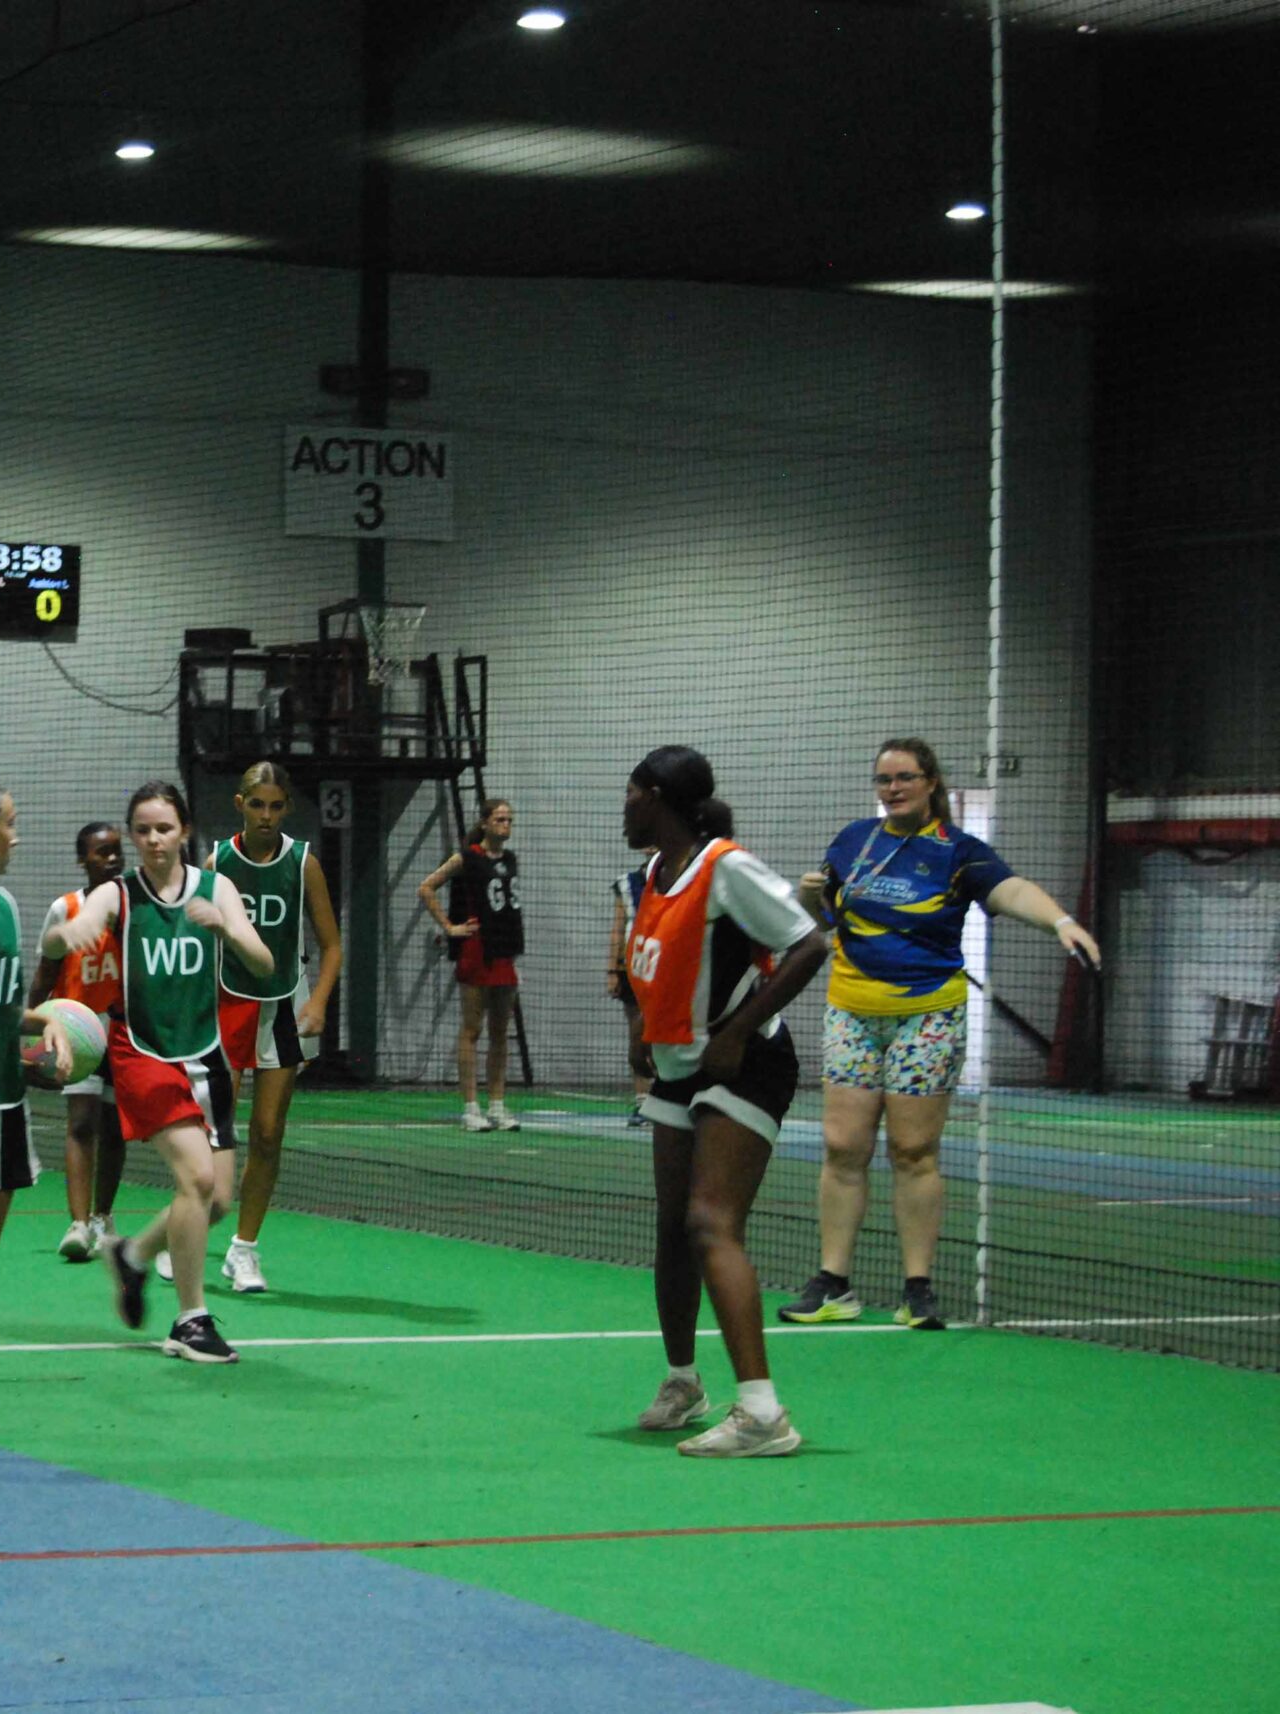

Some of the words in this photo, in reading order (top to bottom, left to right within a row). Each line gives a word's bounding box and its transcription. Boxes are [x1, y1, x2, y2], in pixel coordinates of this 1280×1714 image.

[292, 435, 446, 479] ACTION
[354, 481, 385, 532] 3
[35, 589, 62, 622] 0
[326, 788, 345, 822] 3
[80, 950, 119, 986] GA
[141, 935, 204, 977] WD
